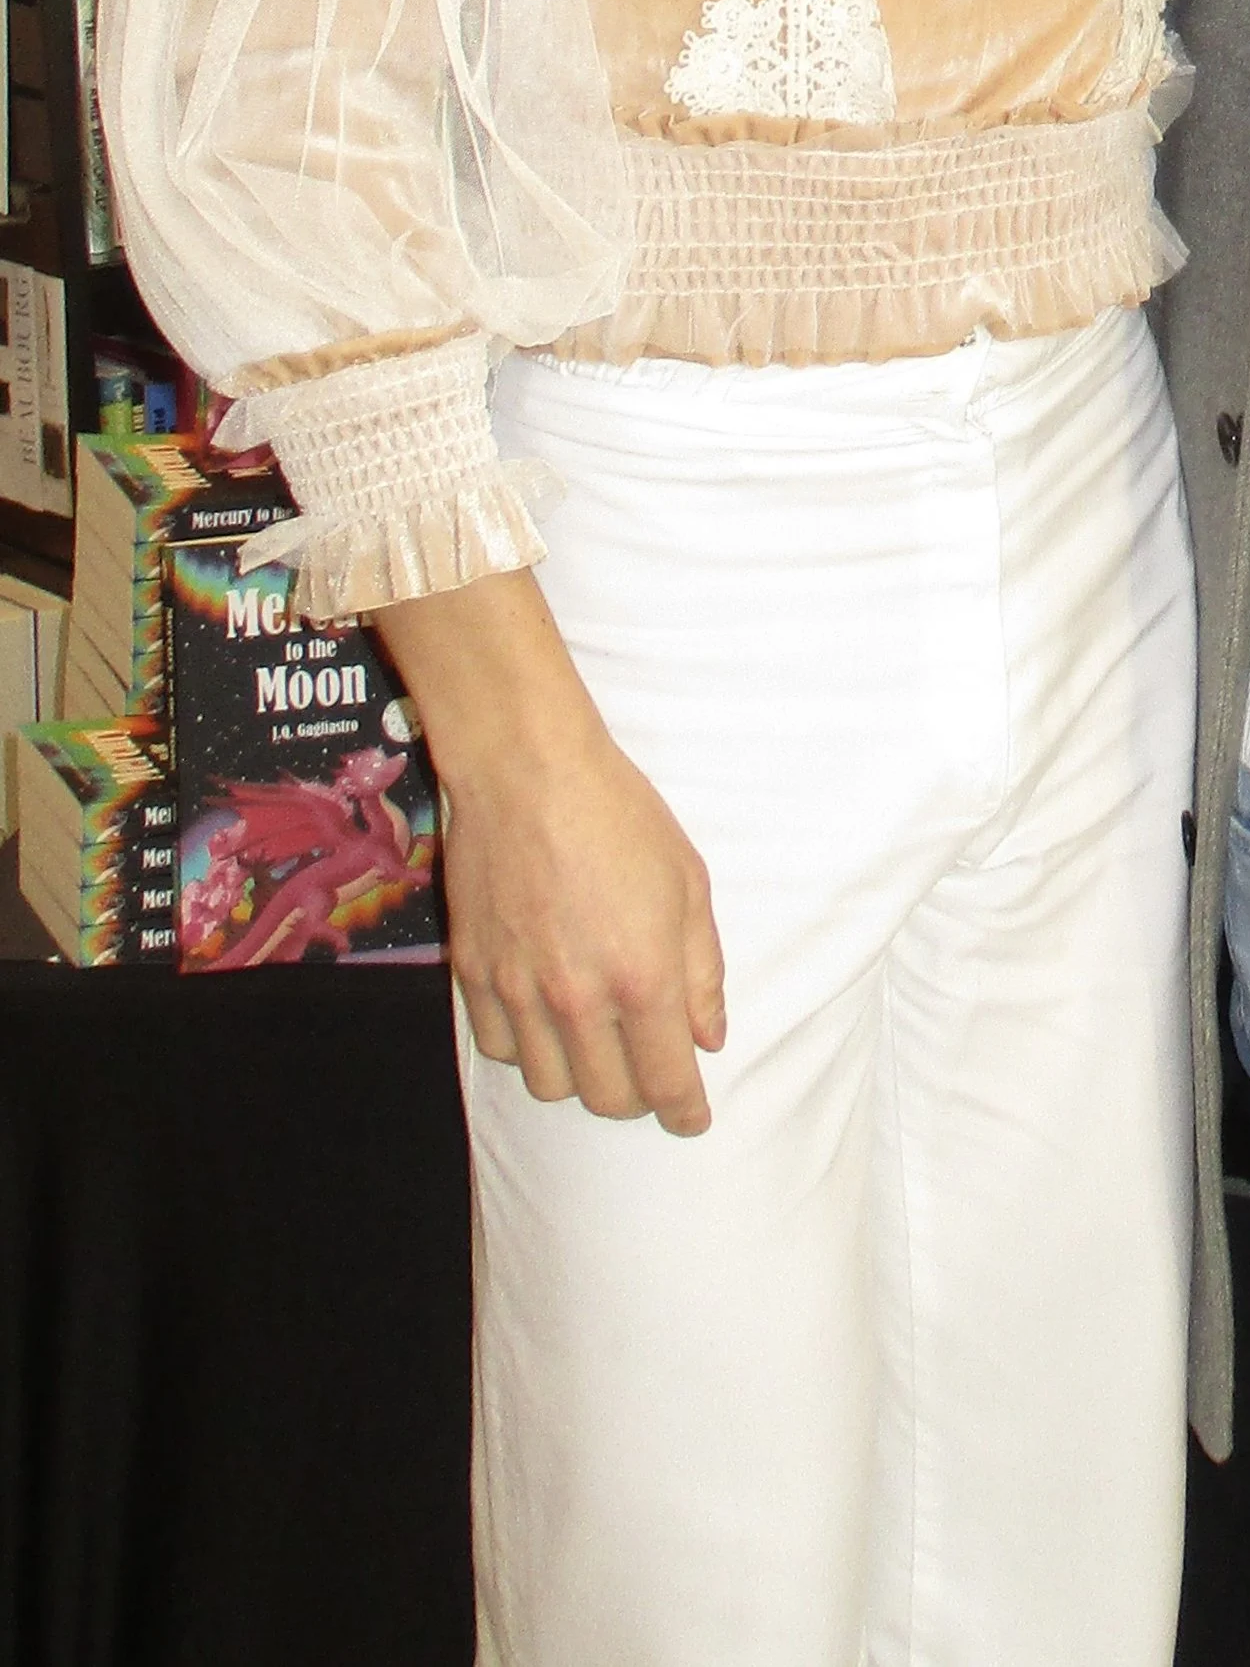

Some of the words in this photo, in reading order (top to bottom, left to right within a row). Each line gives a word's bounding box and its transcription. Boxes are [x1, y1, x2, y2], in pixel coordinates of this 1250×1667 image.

[192, 509, 253, 530] Mercury
[257, 508, 270, 522] to
[286, 641, 303, 661] to
[309, 638, 337, 659] the
[256, 664, 367, 713] Moon
[297, 719, 359, 738] Gagliastro
